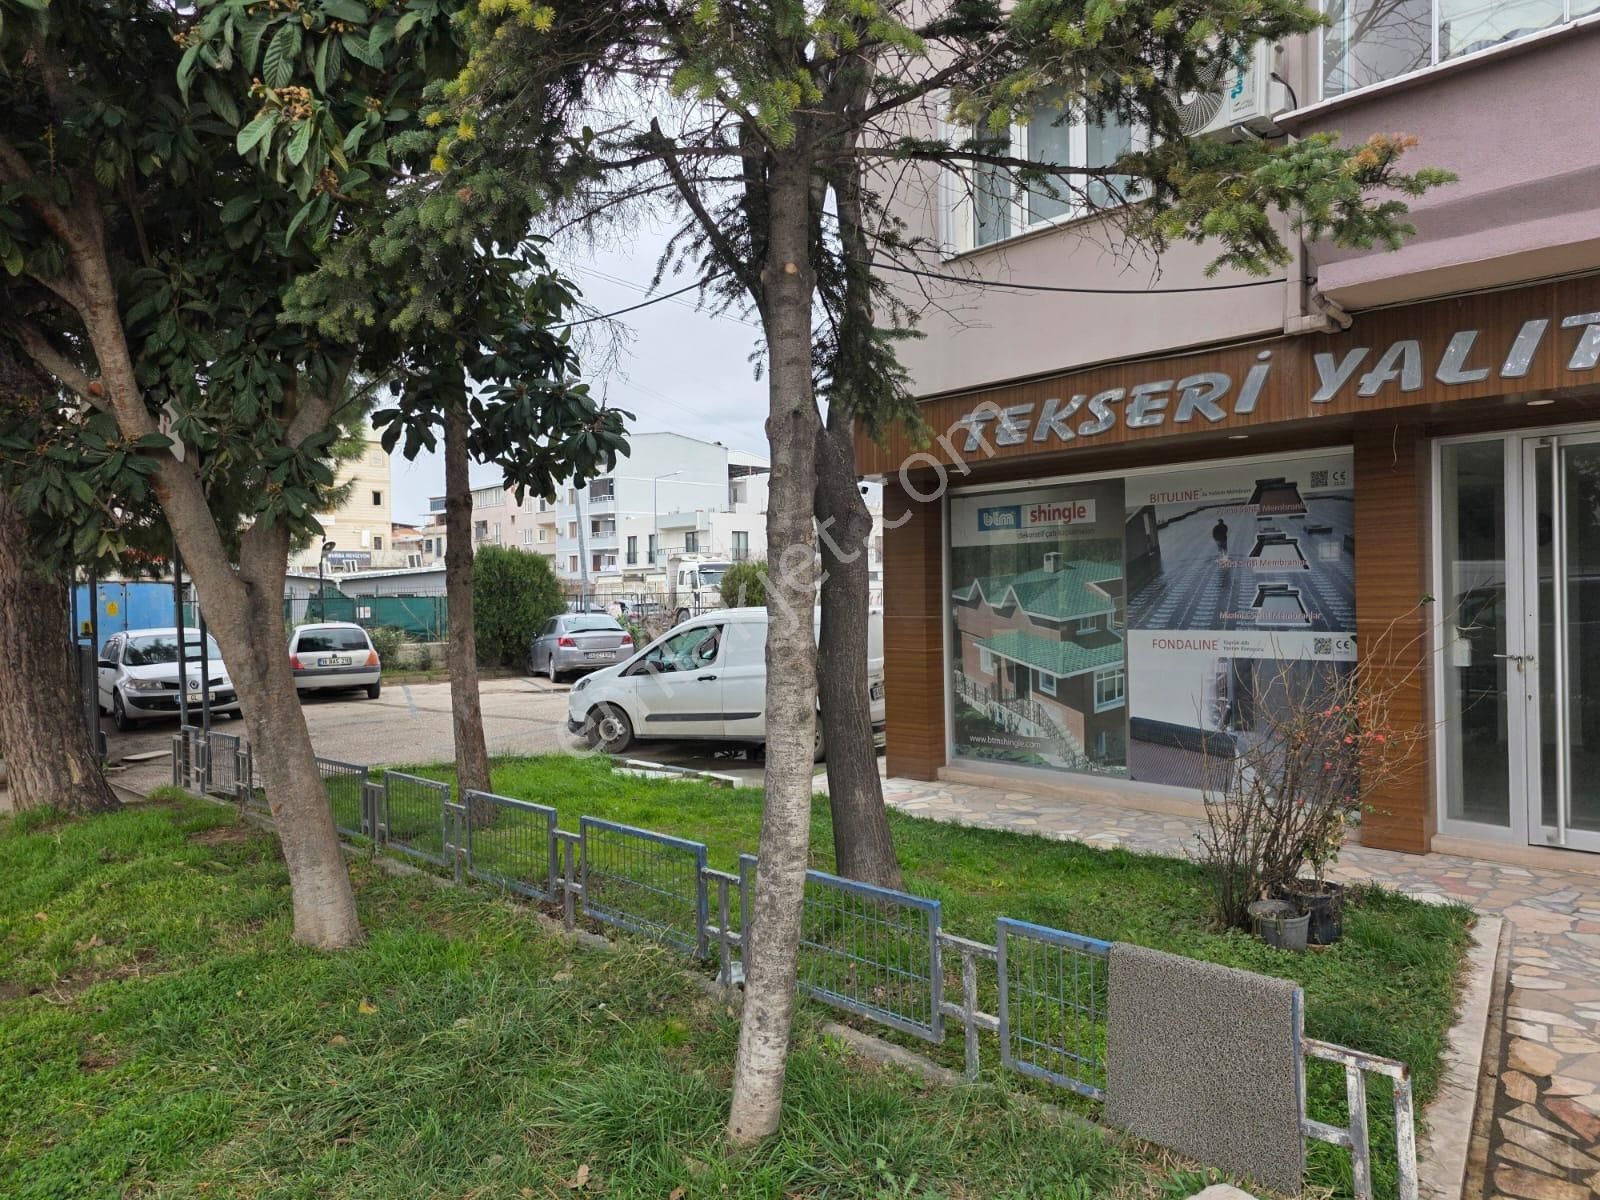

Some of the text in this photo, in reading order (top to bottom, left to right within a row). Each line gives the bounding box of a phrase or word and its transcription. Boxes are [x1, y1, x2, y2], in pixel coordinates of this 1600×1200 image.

[960, 311, 1600, 452] TEKSERİ YALIT
[1150, 489, 1200, 504] BITULINE
[983, 501, 1086, 527] btm shingle
[1152, 639, 1218, 651] FONDALINE
